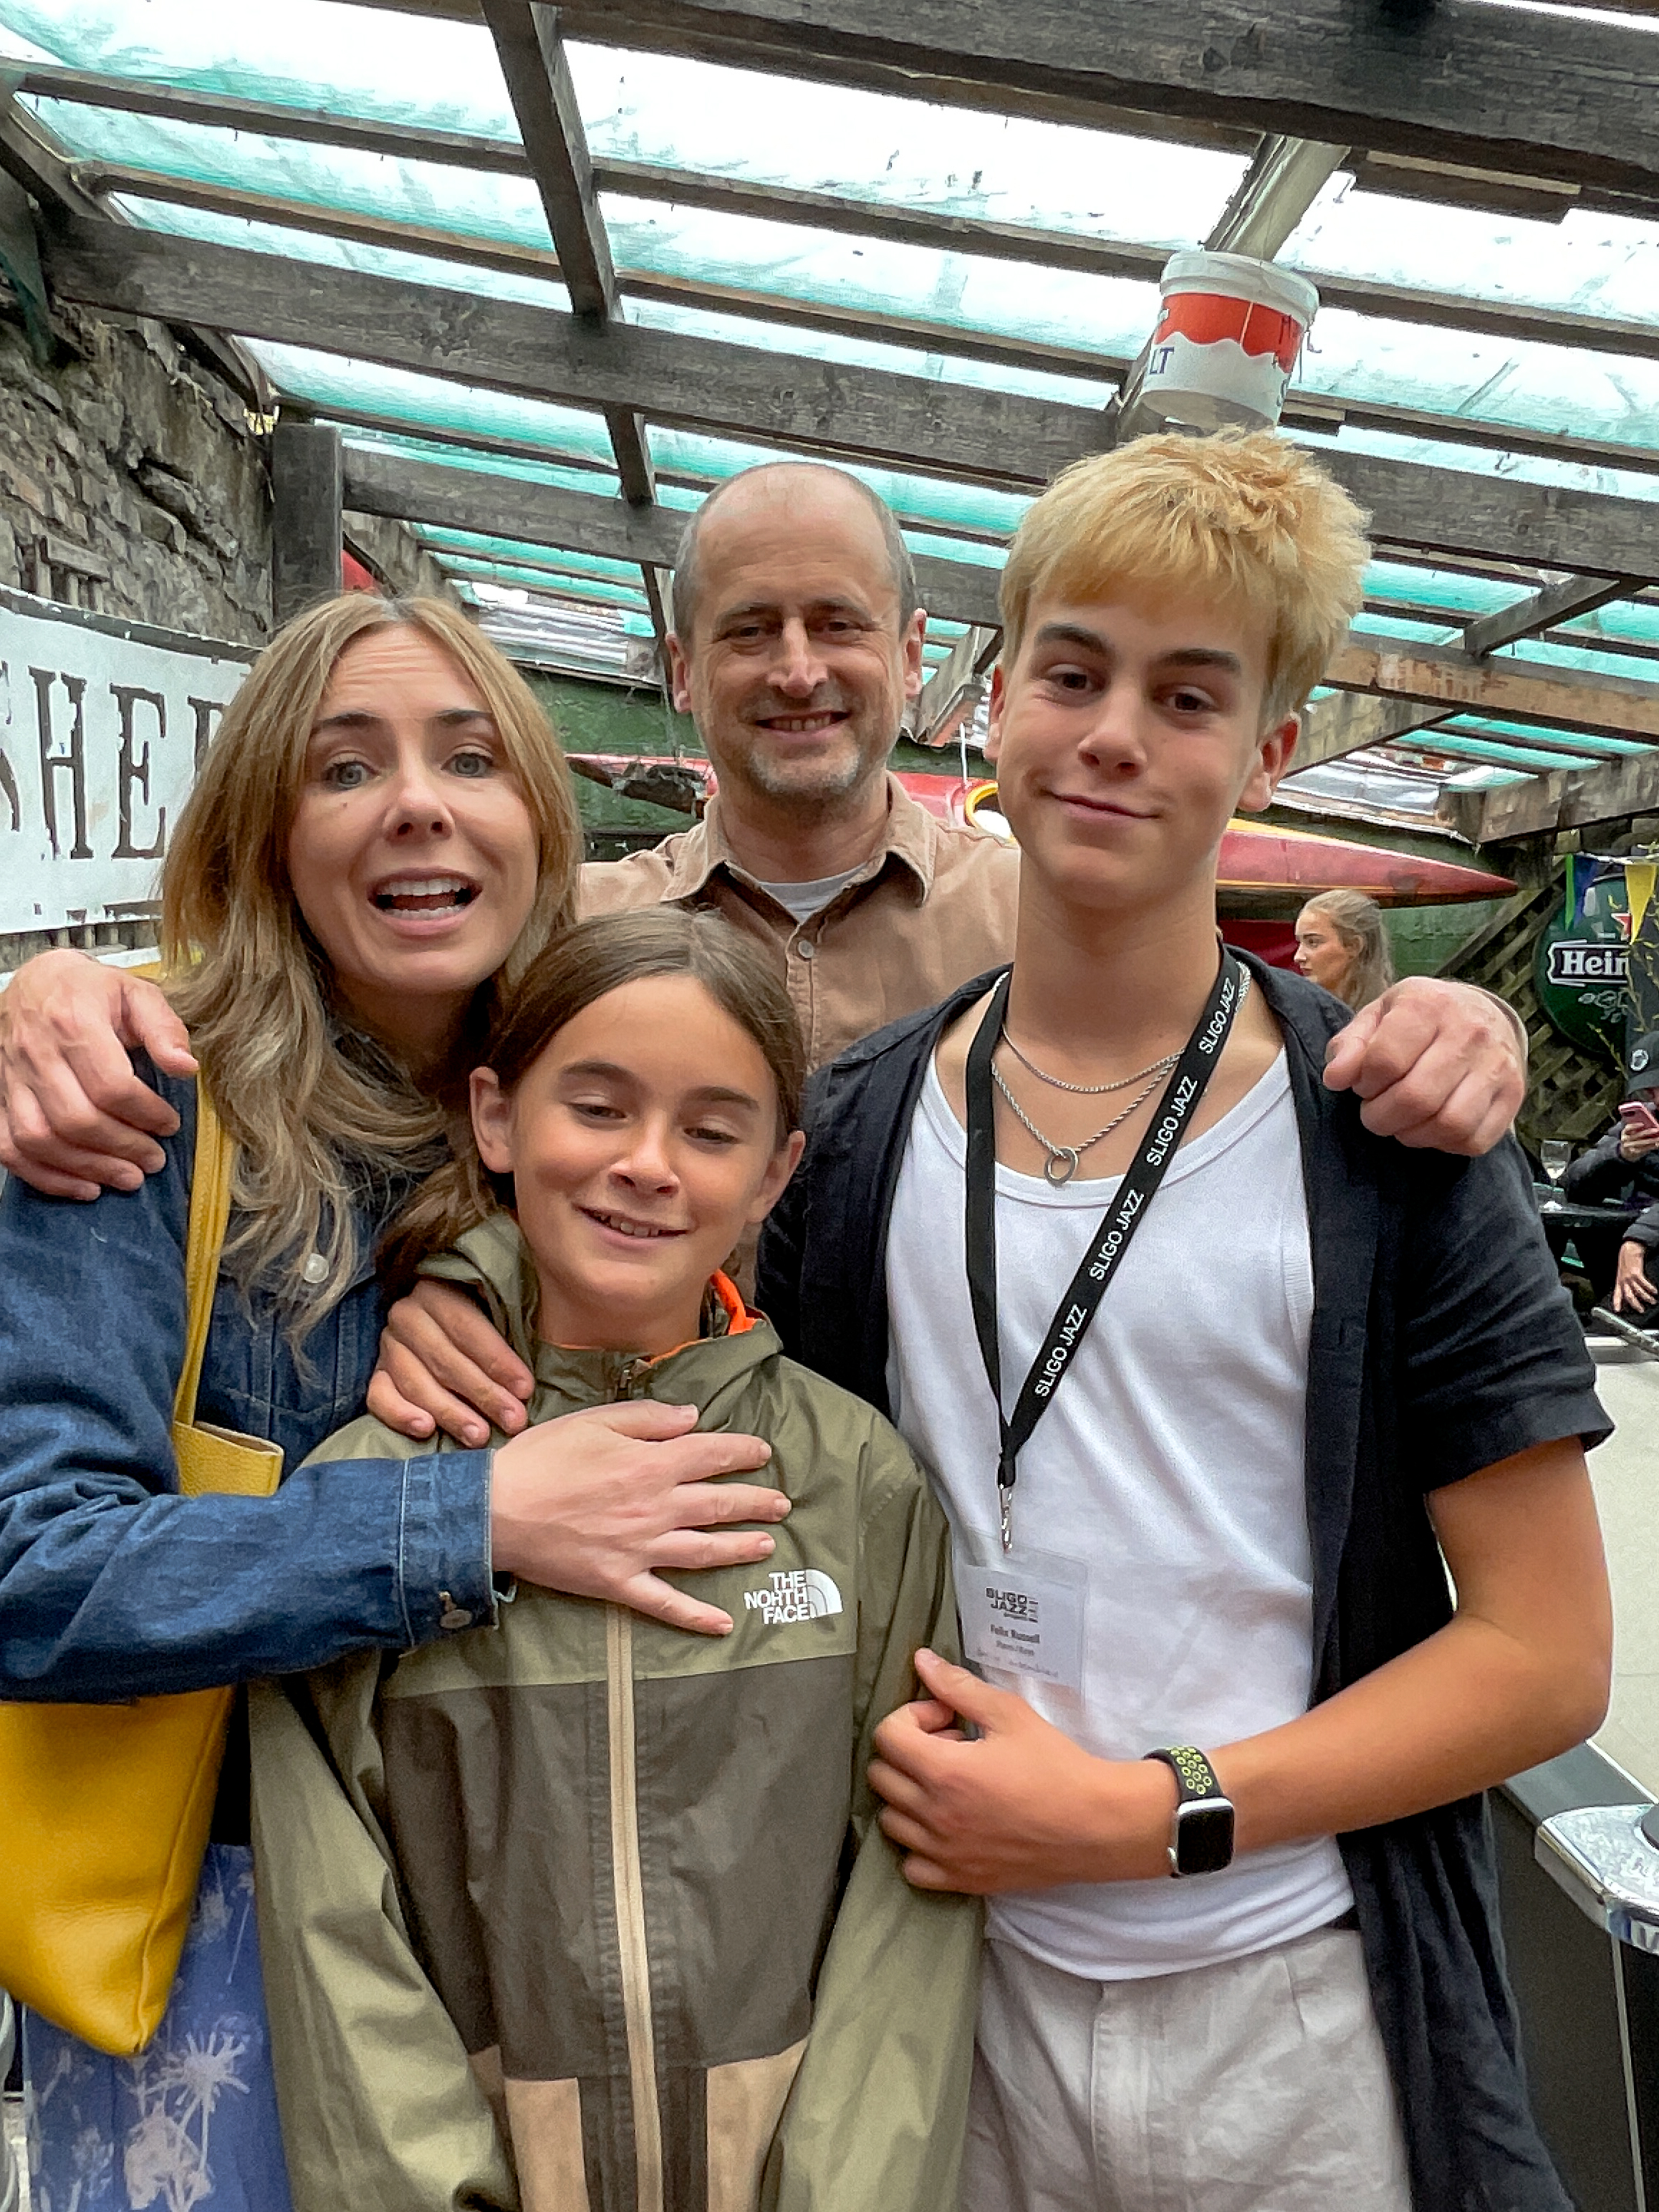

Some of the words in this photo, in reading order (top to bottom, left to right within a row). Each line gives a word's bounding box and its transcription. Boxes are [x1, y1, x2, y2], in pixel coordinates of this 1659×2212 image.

[1149, 347, 1175, 375] LT
[1562, 950, 1629, 976] Hein
[1198, 1010, 1227, 1054] SLIGO
[1219, 977, 1235, 1014] JAZZ
[1146, 1116, 1179, 1167] SLIGO
[1170, 1075, 1198, 1117] JAZZ
[1089, 1231, 1123, 1281] SLIGO
[1116, 1189, 1145, 1231] JAZZ
[1034, 1347, 1068, 1397] SLIGO
[1059, 1304, 1087, 1347] JAZZ
[768, 1570, 807, 1590] THE
[744, 1586, 808, 1610] NORTH
[990, 1601, 1027, 1615] JAZZ
[764, 1603, 809, 1625] FACE
